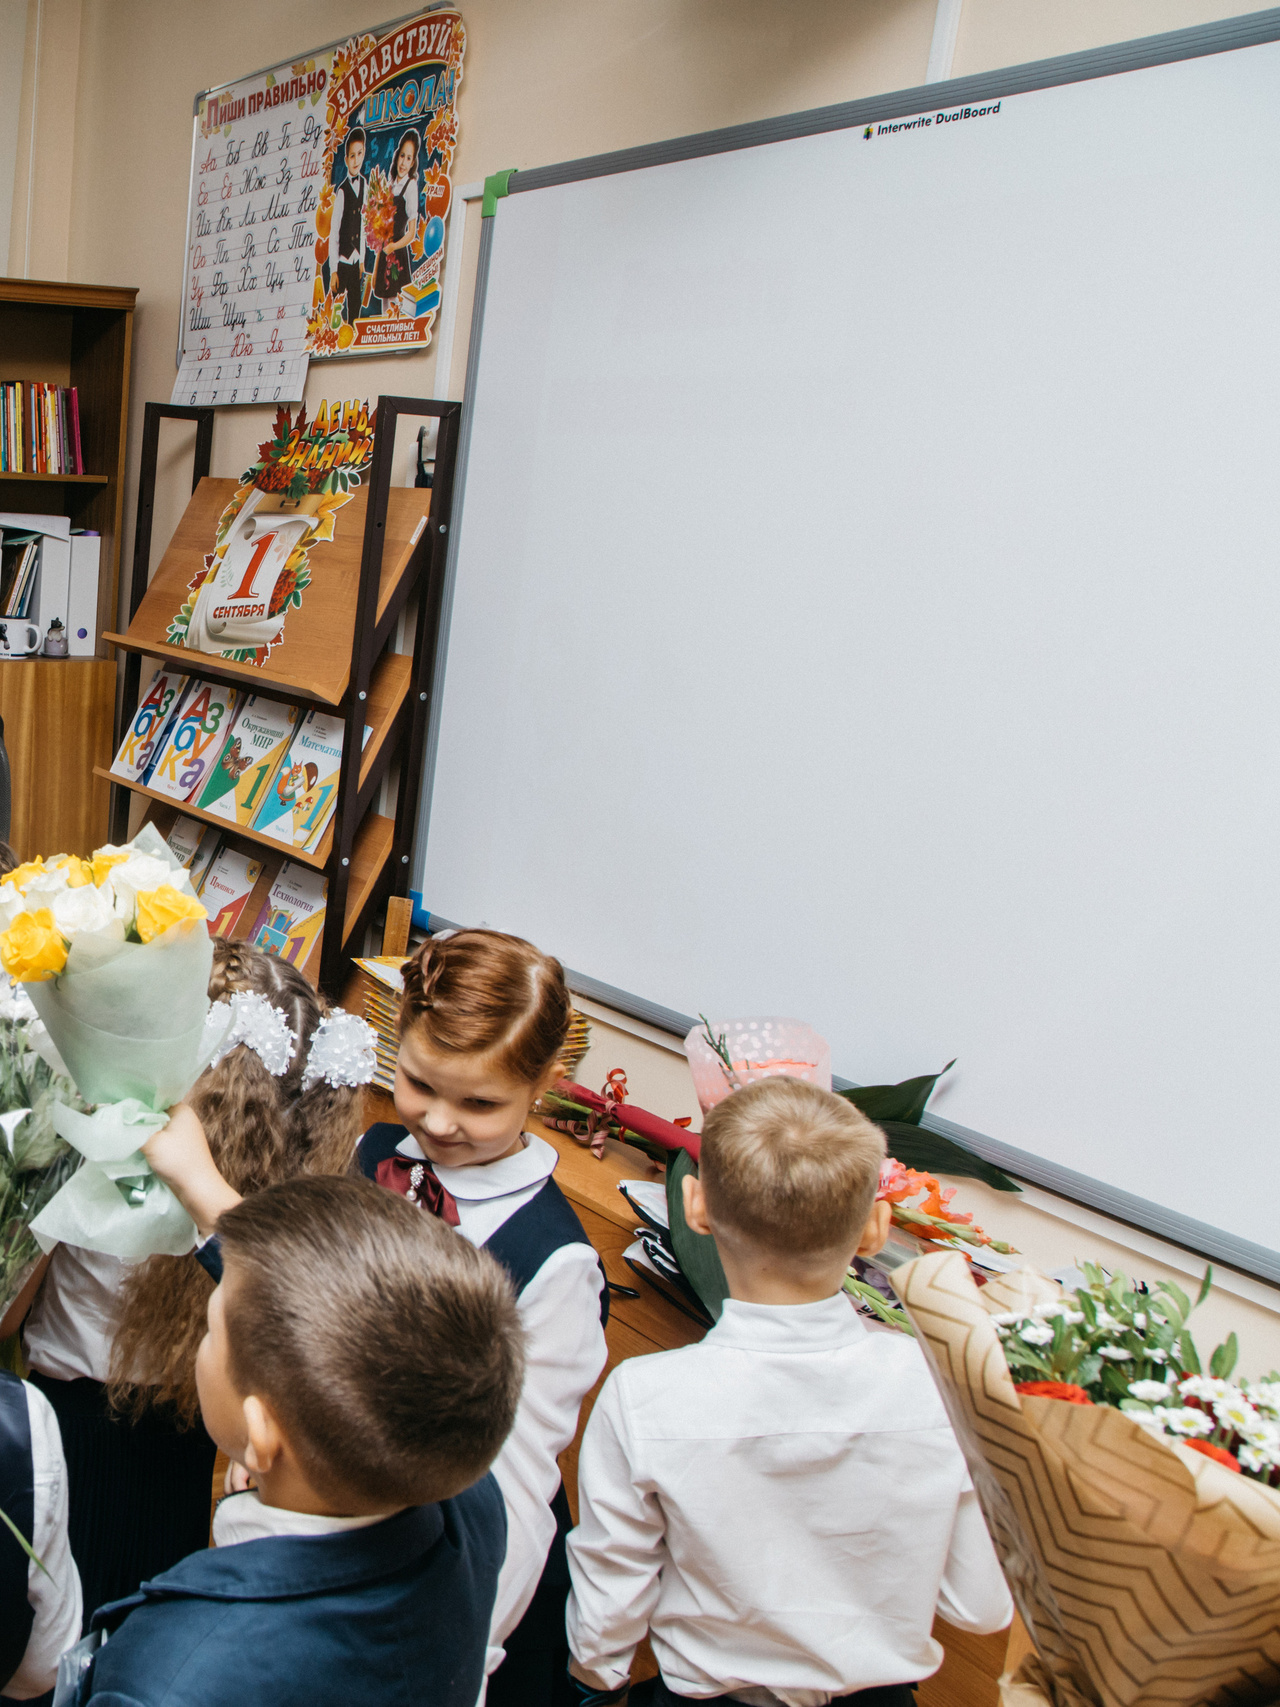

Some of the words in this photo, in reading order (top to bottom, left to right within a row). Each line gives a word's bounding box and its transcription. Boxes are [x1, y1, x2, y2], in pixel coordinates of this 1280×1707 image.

[207, 98, 245, 129] ПИШИ
[248, 69, 327, 115] ПРАВИЛЬНО
[364, 69, 456, 126] ШКОЛА!
[877, 117, 932, 136] Interwrite
[935, 101, 1002, 124] DualBoard
[199, 148, 217, 175] Аа
[226, 140, 245, 166] Бб
[252, 131, 269, 158] Вв
[300, 115, 322, 149] Дд
[240, 166, 266, 195] Жж
[276, 158, 293, 194] Зз
[301, 151, 320, 179] Ии
[197, 210, 212, 238] Йй
[216, 206, 233, 233] Кк
[239, 201, 257, 227] Лл
[262, 194, 290, 222] Мм
[298, 185, 317, 214] Нн
[193, 246, 206, 269] Оо
[213, 239, 229, 265] Пп
[241, 233, 257, 266] Рр
[267, 227, 280, 254] Сс
[288, 221, 314, 250] Тт
[191, 276, 204, 307] Уу
[211, 272, 229, 304] Фф
[238, 266, 258, 292] Хх
[265, 262, 284, 293] Цц
[294, 257, 310, 282] Чч
[190, 307, 211, 331] Шш
[222, 302, 247, 331] Щщ
[277, 306, 286, 319] ы
[366, 322, 415, 334] СЧАСТЛИВЫХ
[198, 337, 211, 361] Ээ
[231, 333, 253, 358] Юю
[267, 328, 284, 354] Яя
[361, 333, 402, 344] ШКОЛЬНЫХ
[403, 331, 420, 341] ЛЕТ!
[196, 368, 202, 381] 1
[216, 366, 222, 381] 2
[236, 364, 242, 379] 3
[258, 362, 263, 376] 4
[279, 360, 286, 375] 5
[190, 392, 197, 405] 6
[211, 390, 218, 404] 7
[231, 389, 238, 403] 8
[252, 388, 259, 402] 9
[273, 386, 280, 401] 0
[310, 399, 370, 438] ДЕНЬ
[227, 531, 279, 600] 1
[213, 604, 265, 619] СЕНТЯБРЯ
[241, 717, 285, 739] Окружающий
[250, 734, 274, 749] МИР
[240, 764, 270, 809] 1
[300, 784, 334, 831] 1
[272, 883, 314, 912] Технология
